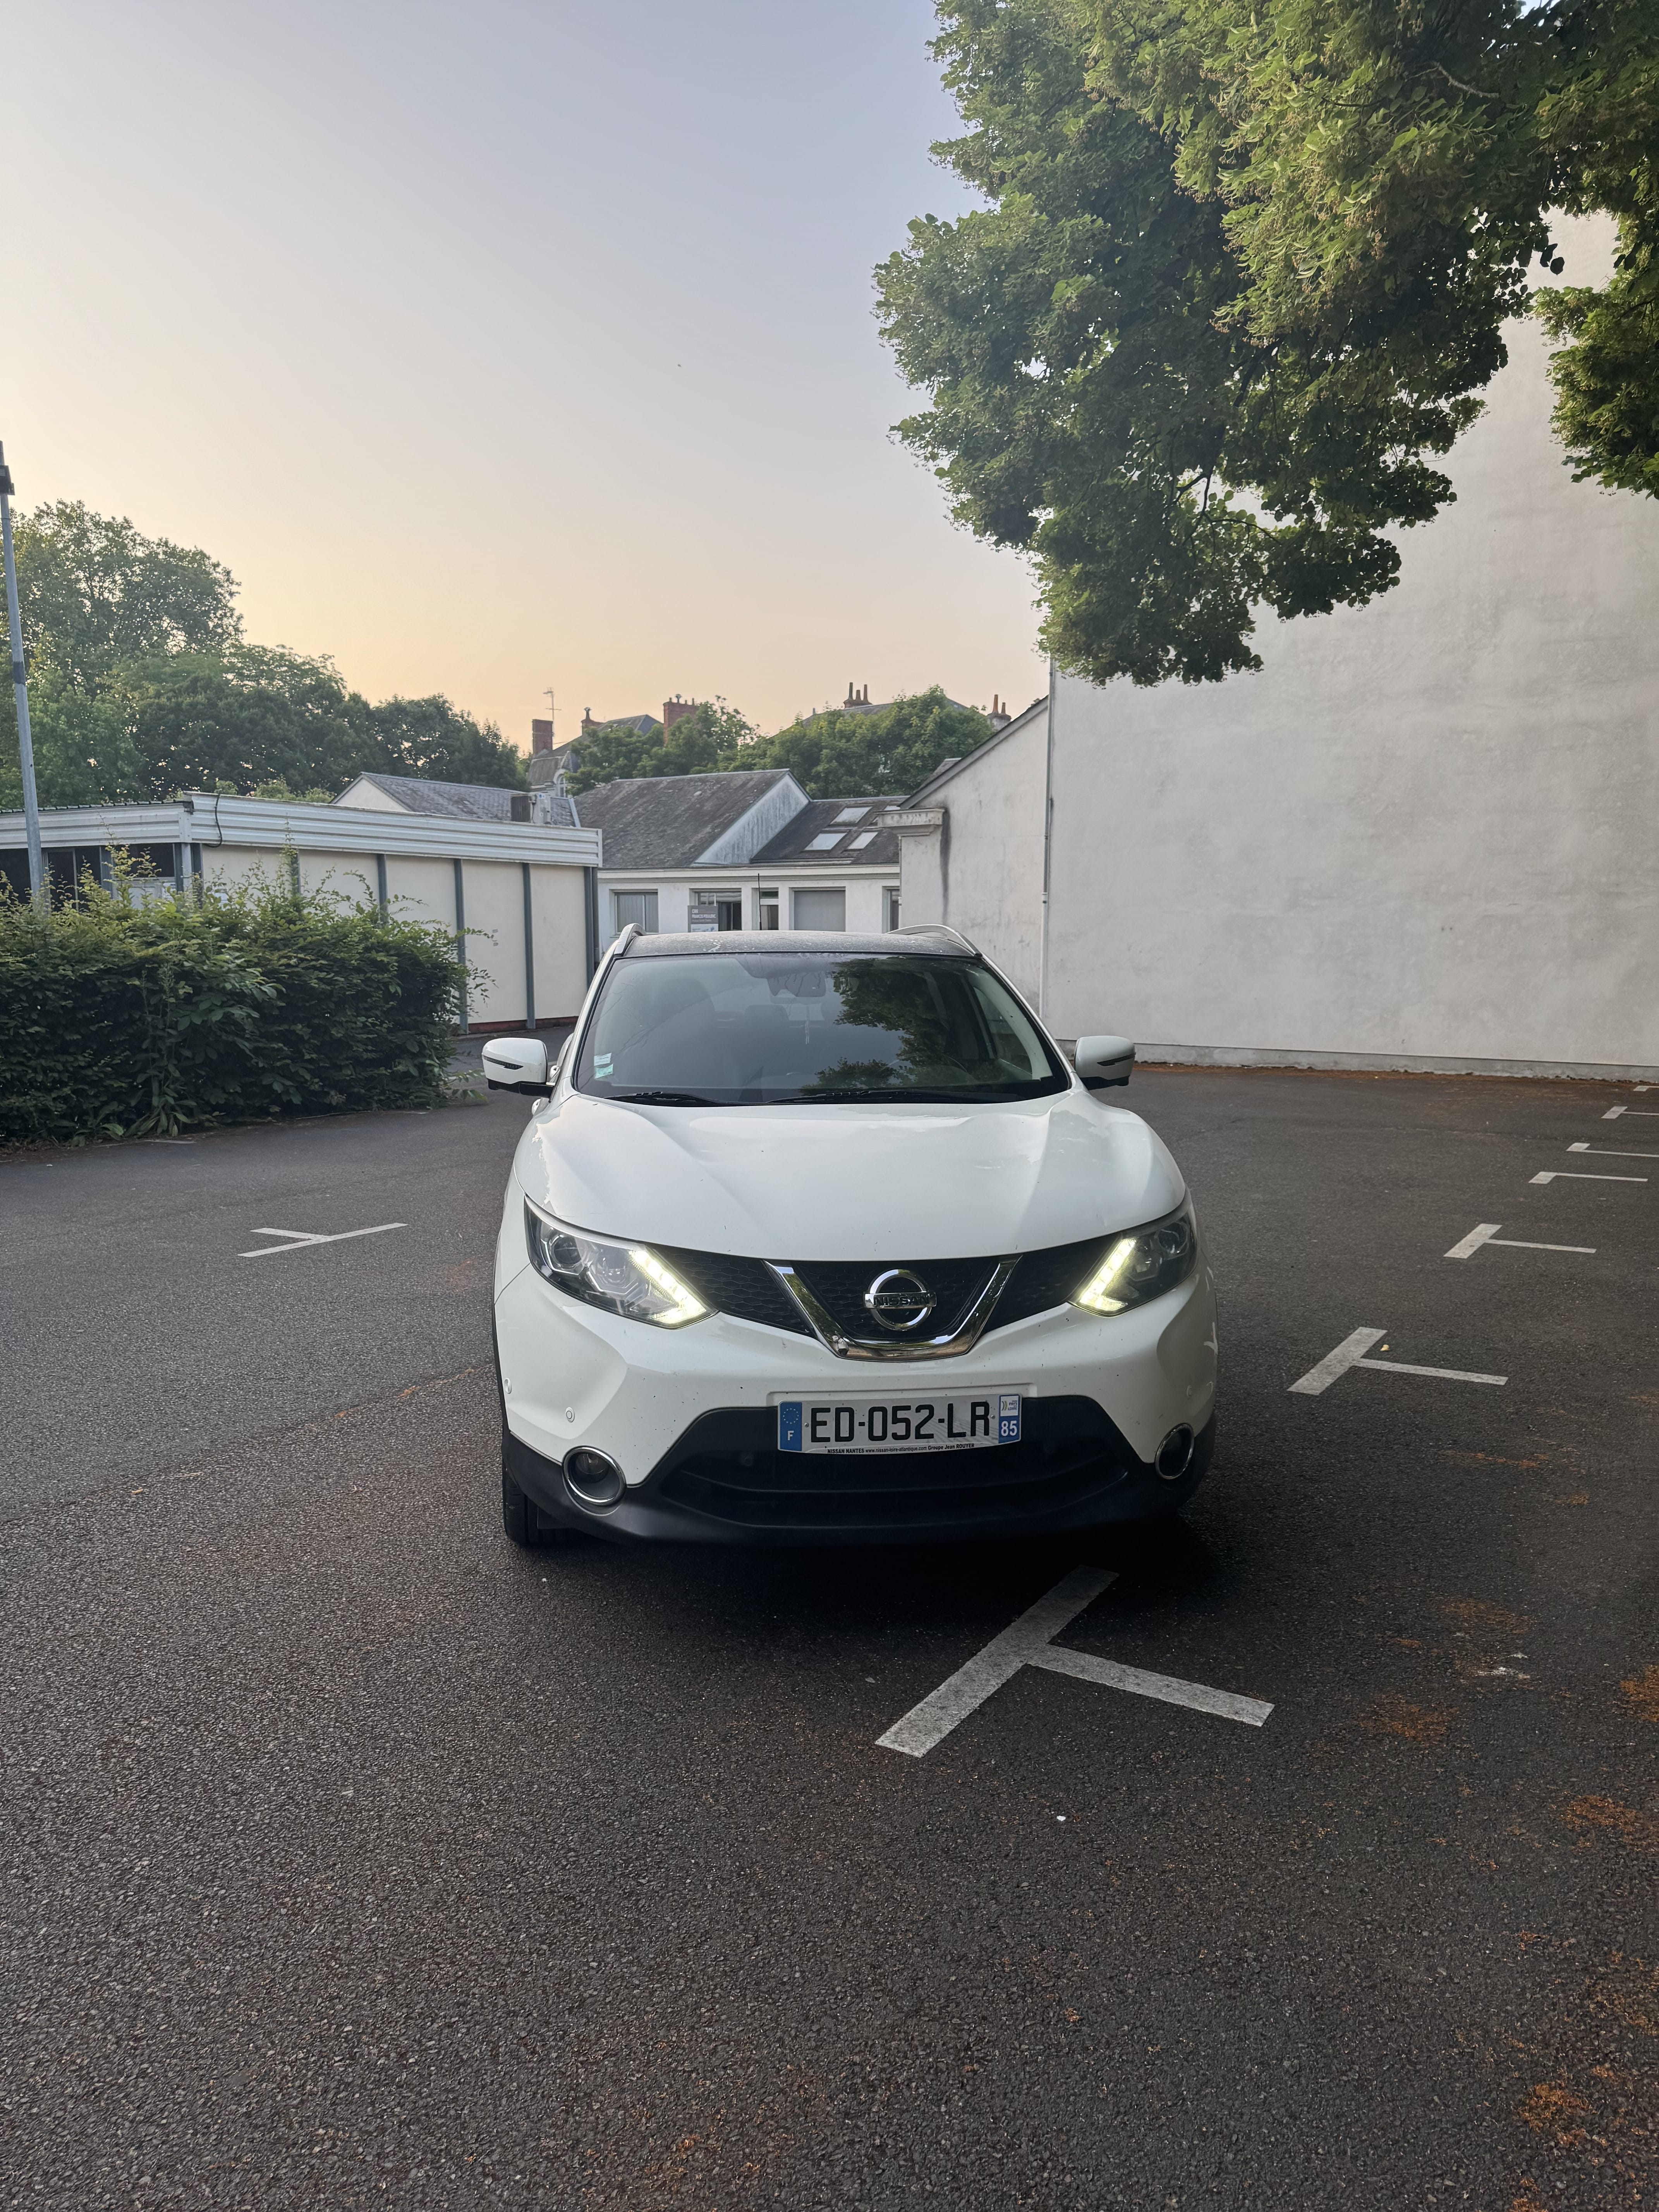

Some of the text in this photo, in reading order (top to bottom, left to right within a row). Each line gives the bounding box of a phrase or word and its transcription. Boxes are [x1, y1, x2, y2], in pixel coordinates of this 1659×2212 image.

[874, 1294, 930, 1306] NISSAN
[811, 1401, 989, 1443] ED-052-LR
[1001, 1420, 1017, 1436] 85
[788, 1431, 794, 1441] F
